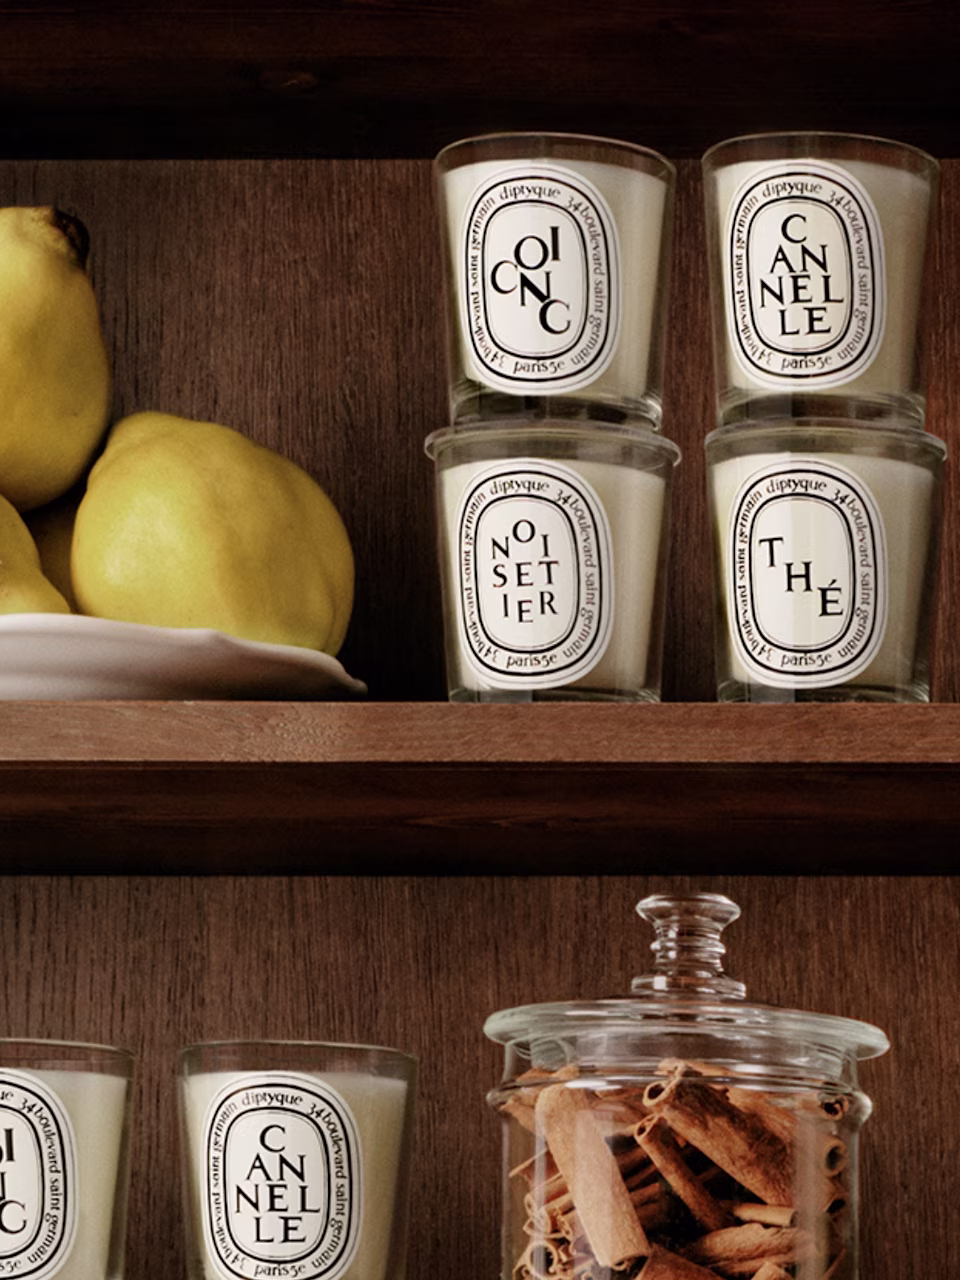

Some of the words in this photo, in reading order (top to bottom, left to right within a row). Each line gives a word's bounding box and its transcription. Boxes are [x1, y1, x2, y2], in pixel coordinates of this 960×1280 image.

[499, 185, 561, 202] diptyque
[762, 182, 823, 198] diptyque
[490, 479, 551, 496] diptyque
[766, 478, 828, 495] diptyque
[242, 1091, 303, 1108] diptyque
